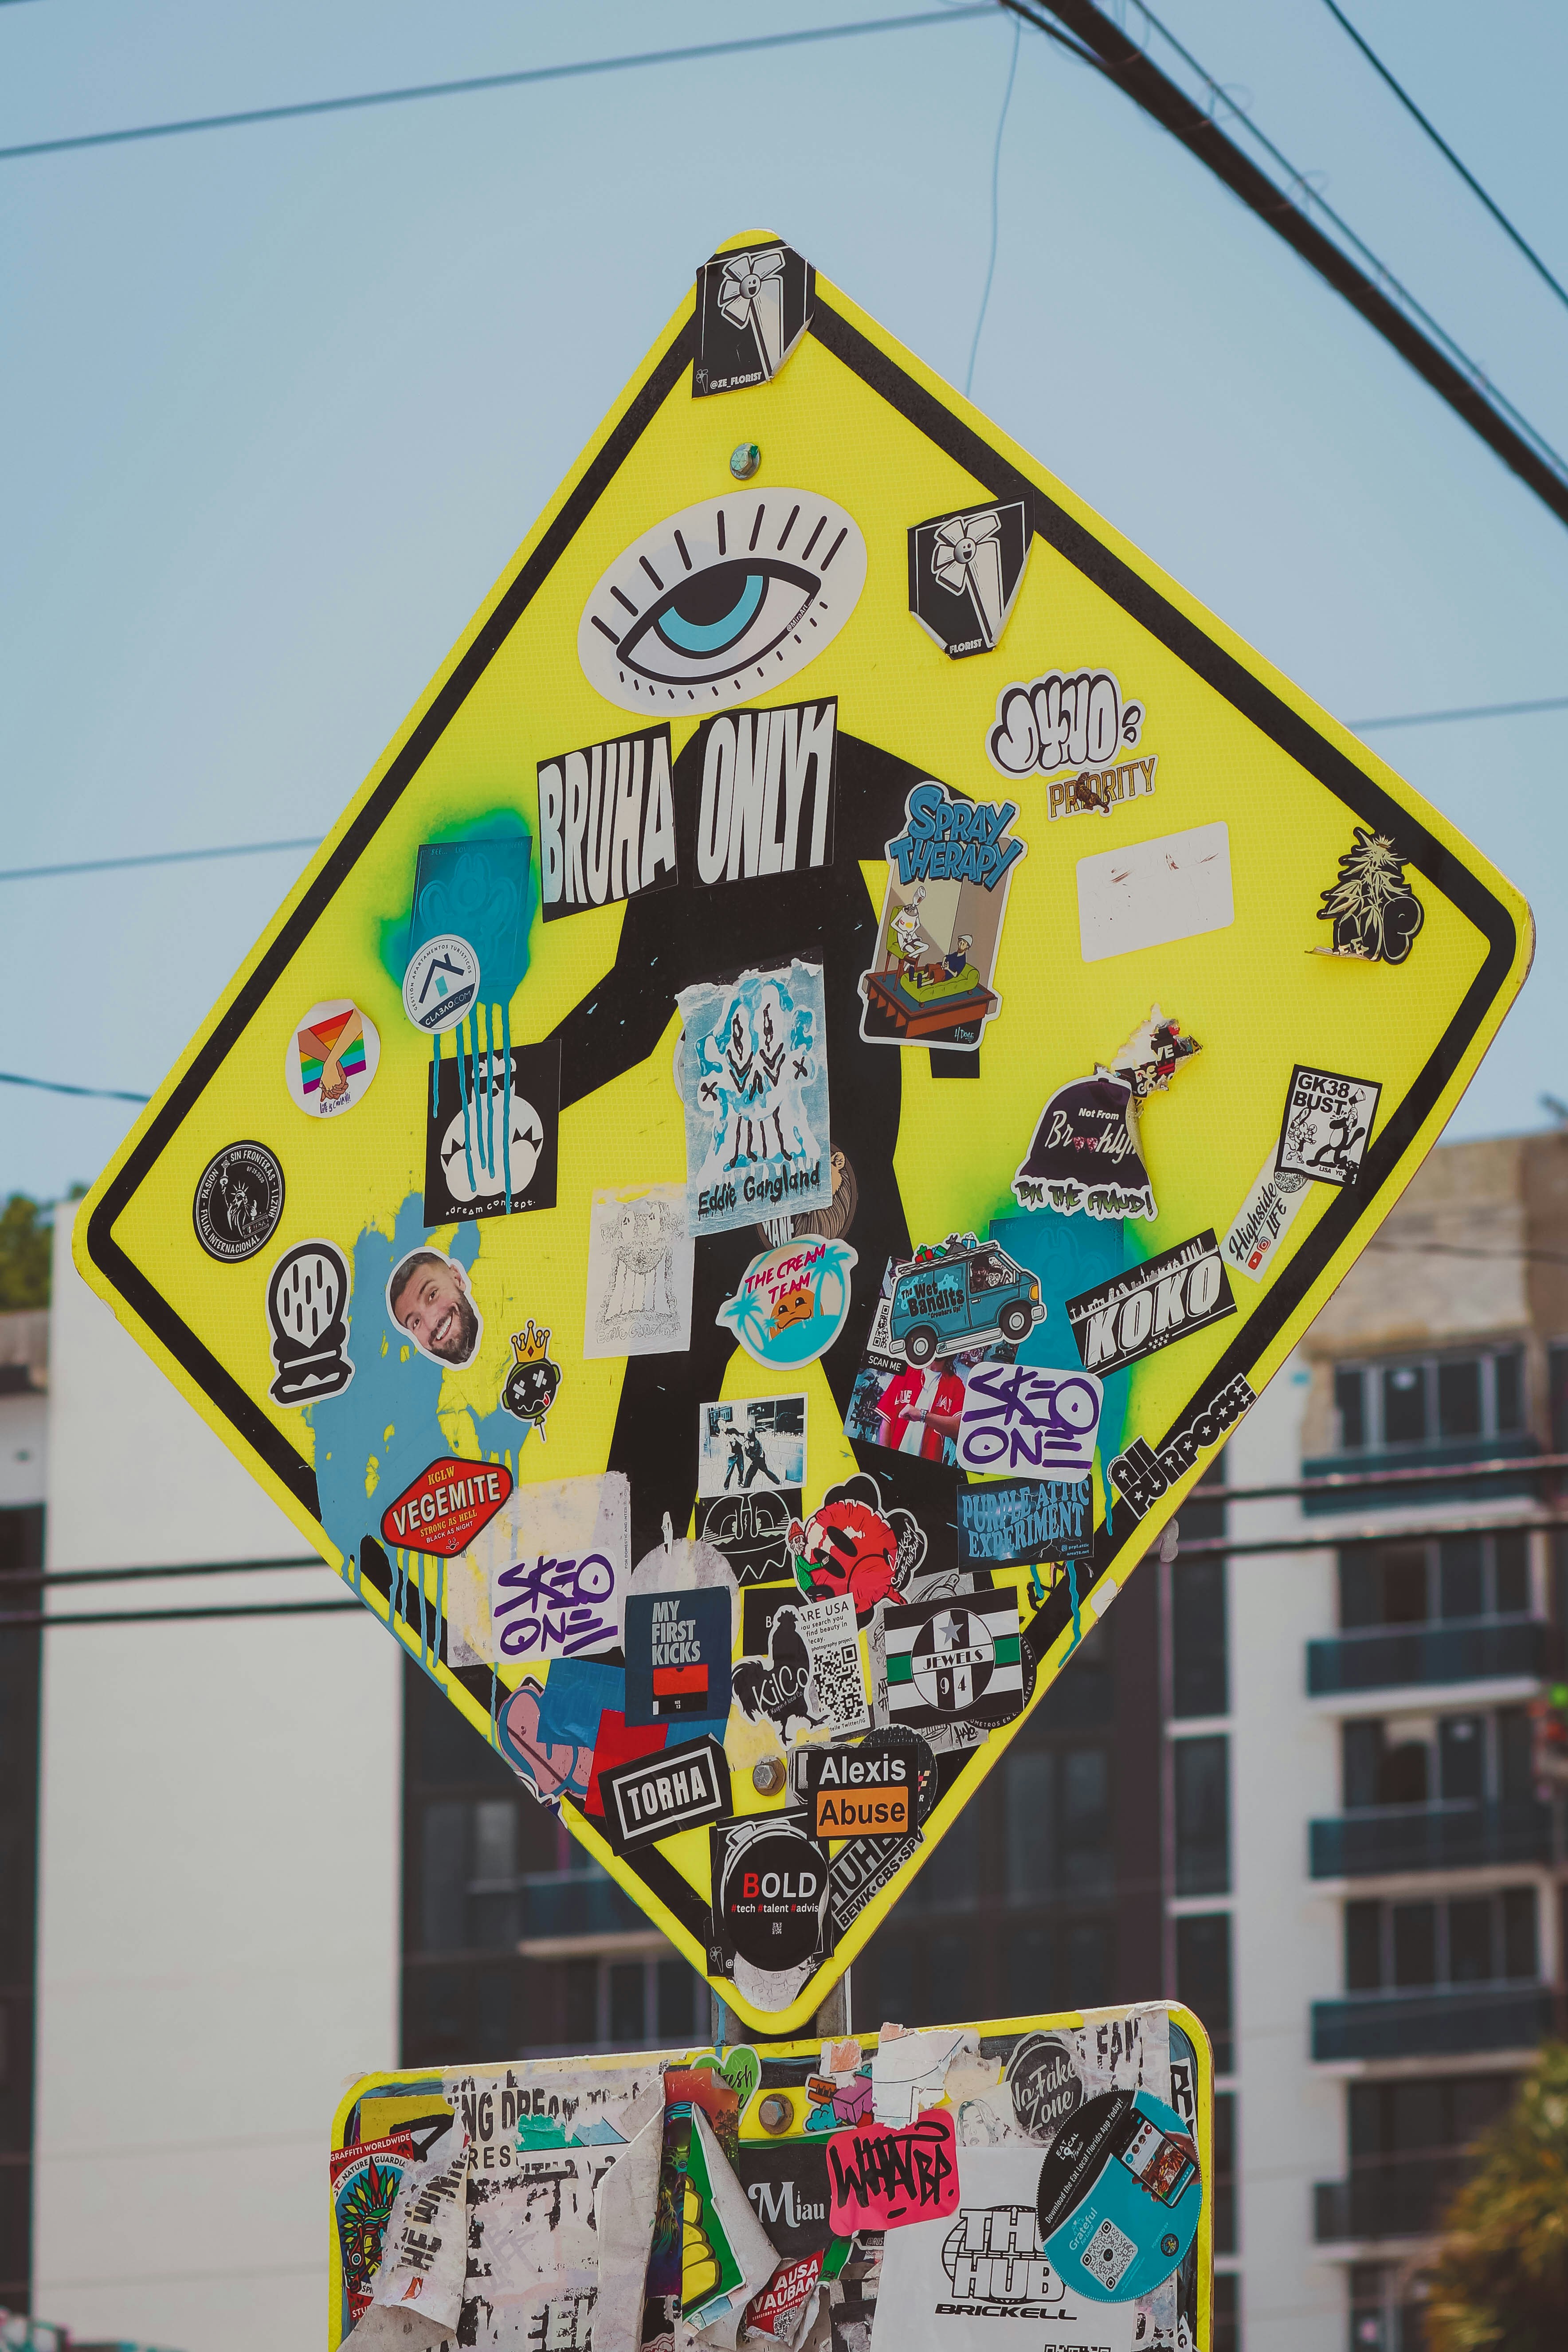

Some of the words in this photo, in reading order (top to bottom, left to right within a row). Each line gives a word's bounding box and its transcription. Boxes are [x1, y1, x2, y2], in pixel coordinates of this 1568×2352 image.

[710, 371, 762, 389] @ZE_FLORIST
[949, 638, 982, 654] FLORIST
[538, 737, 676, 904] BRUHA
[698, 703, 836, 884] ONLY
[907, 784, 1016, 845] SPRAY
[889, 838, 1025, 893] THERAPY
[412, 944, 448, 979] APARTAMENTOS
[451, 945, 472, 974] TURISTICOS
[1298, 1074, 1350, 1099] GK38
[1078, 1108, 1096, 1117] Not
[1097, 1109, 1119, 1120] From
[1292, 1091, 1348, 1116] BUST
[1045, 1110, 1136, 1164] Brklyn
[230, 1150, 241, 1162] SIN
[243, 1149, 276, 1181] FRONTERAS
[201, 1168, 219, 1199] PASION
[698, 1182, 737, 1220] Eddie
[743, 1161, 820, 1205] Gangland
[200, 1208, 212, 1236] FILIAL
[208, 1234, 260, 1254] INTERNACIONAL
[1229, 1182, 1278, 1262] Highside
[1265, 1197, 1287, 1240] LIFE
[745, 1268, 774, 1293] THE
[776, 1243, 826, 1279] CREAM
[768, 1272, 811, 1304] TEAM
[901, 1286, 913, 1300] The
[914, 1282, 938, 1299] Wet
[908, 1288, 964, 1317] Bandits
[1083, 1255, 1222, 1368] KOKO
[868, 1355, 889, 1368] SCAN
[889, 1361, 902, 1372] ME
[962, 1426, 1093, 1470] ONE
[427, 1466, 455, 1486] KGLW
[392, 1472, 501, 1536] VEGEMITE
[961, 1486, 1032, 1533] PURPLE
[1036, 1480, 1090, 1510] ATTIC
[420, 1521, 447, 1537] STRONG
[448, 1517, 457, 1527] AS
[459, 1509, 478, 1523] HELL
[426, 1532, 446, 1544] BLACK
[456, 1521, 474, 1533] NIGHT
[968, 1501, 1085, 1561] EXPERIMENT
[652, 1600, 676, 1623] MY
[812, 1618, 831, 1628] search
[832, 1615, 844, 1624] you
[825, 1600, 849, 1616] USA
[500, 1608, 618, 1656] ONE
[652, 1619, 696, 1644] FIRST
[806, 1628, 818, 1637] find
[820, 1623, 840, 1634] beauty
[808, 1636, 826, 1645] ecay.
[652, 1641, 701, 1666] KICKS
[811, 1642, 837, 1653] photography
[923, 1649, 984, 1671] JEWELS
[818, 1753, 906, 1785] Alexis
[627, 1766, 708, 1821] TORHA
[818, 1799, 906, 1827] Abuse
[743, 1872, 817, 1898] BOLD
[731, 1903, 756, 1914] #tech
[757, 1903, 789, 1914] #talent
[1028, 2056, 1078, 2099] Fake
[1025, 2090, 1074, 2136] Zone
[330, 2146, 363, 2162] GRAFFITI
[364, 2133, 410, 2153] WORLDWIDE
[1045, 2190, 1067, 2224] Download
[1063, 2180, 1073, 2192] the
[1070, 2170, 1080, 2182] Eat
[1077, 2154, 1089, 2173] Local
[1086, 2132, 1103, 2155] Florida
[1100, 2120, 1111, 2135] App
[1107, 2097, 1124, 2123] Today!
[1056, 2139, 1067, 2157] EAT
[341, 2158, 368, 2182] NATURE
[748, 2181, 826, 2228] Miau
[1069, 2207, 1098, 2250] Grateful
[773, 2259, 819, 2292] AUSA
[951, 2255, 1066, 2303] HUB
[935, 2303, 1078, 2321] BRICKELL
